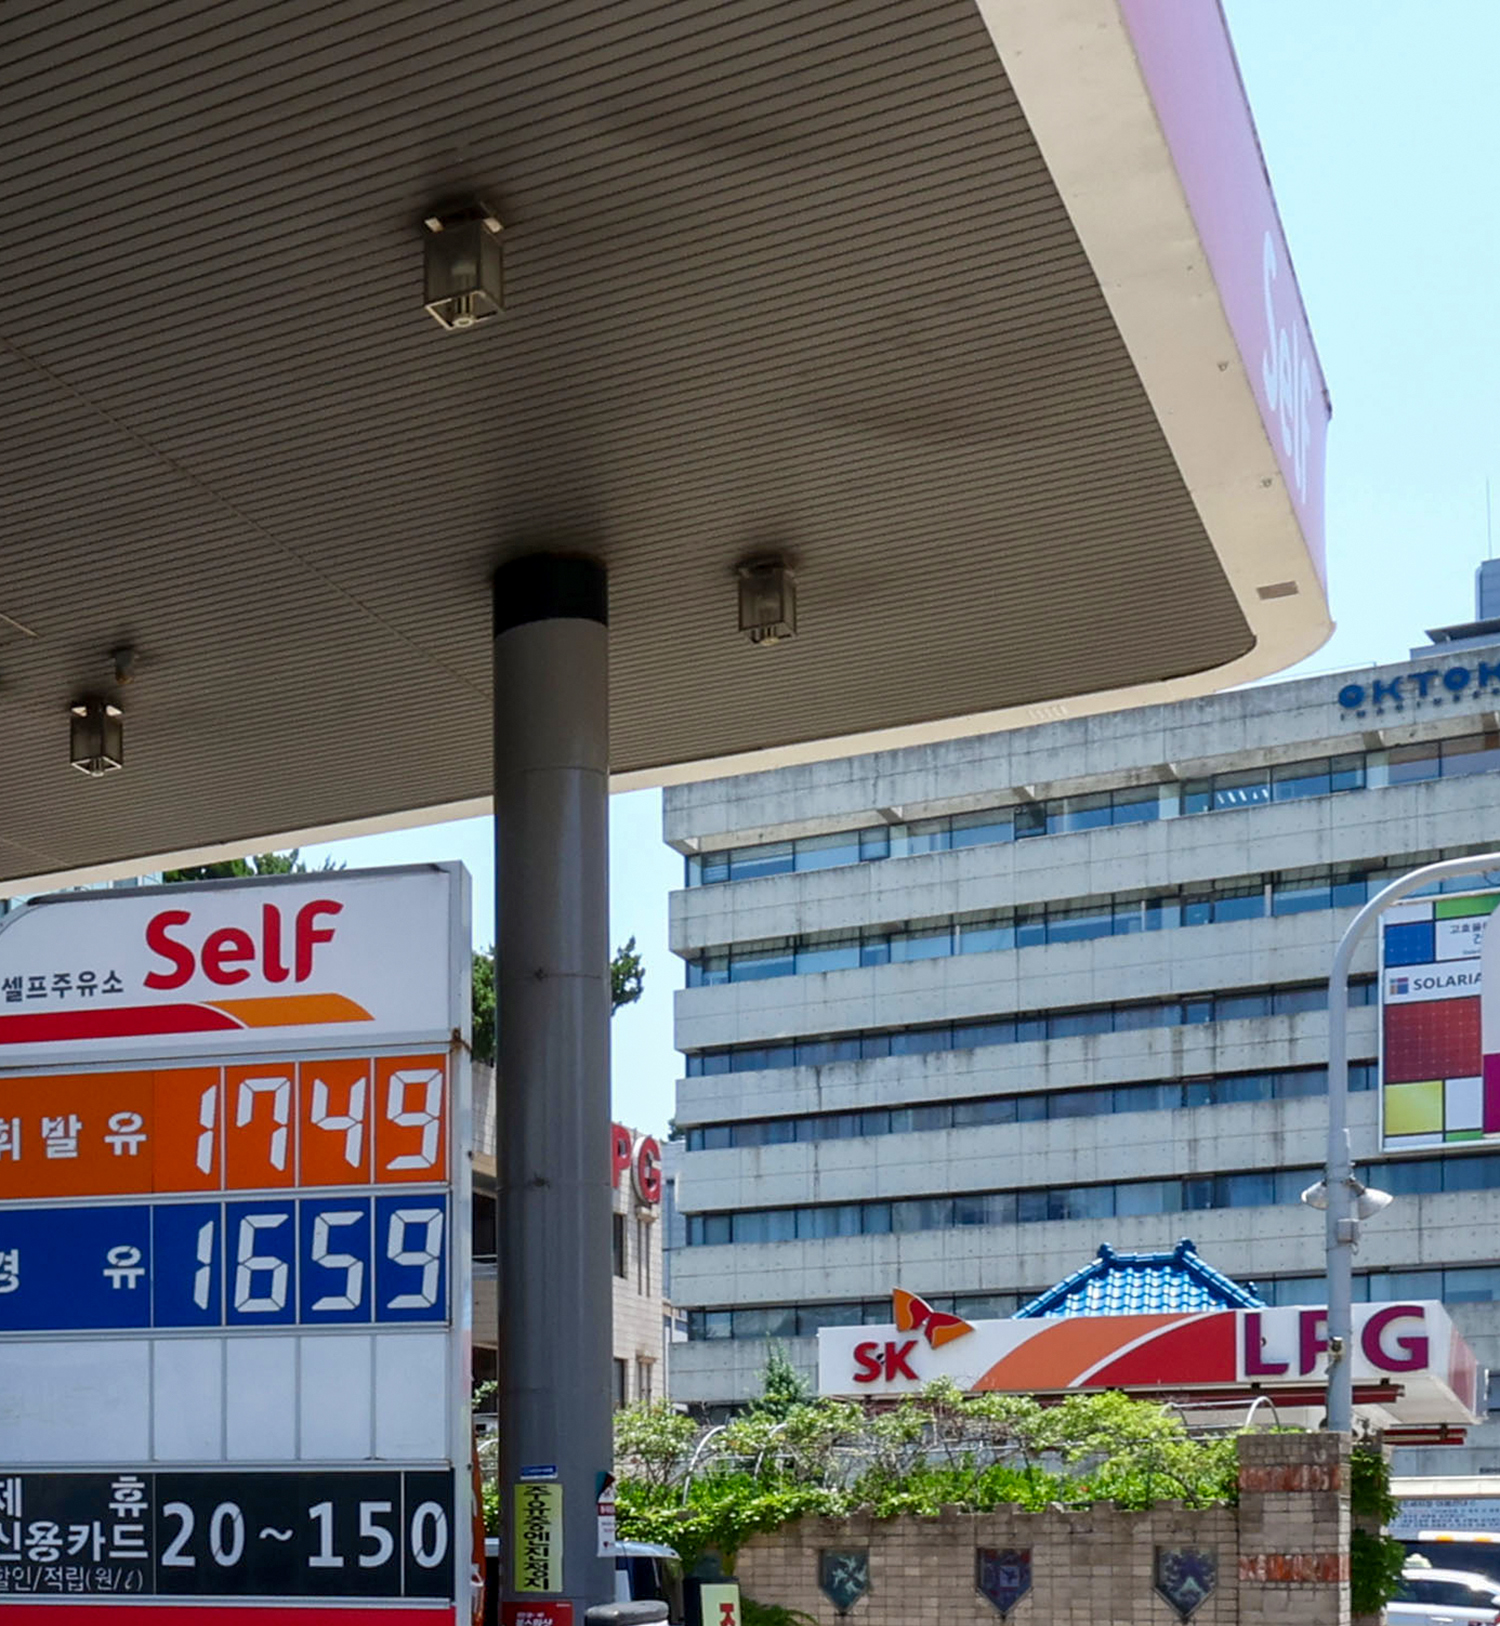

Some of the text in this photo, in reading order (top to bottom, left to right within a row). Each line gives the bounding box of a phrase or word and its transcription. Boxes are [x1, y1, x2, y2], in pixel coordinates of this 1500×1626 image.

[1262, 229, 1312, 506] Self
[1, 970, 124, 1003] 셀프주유소
[143, 899, 345, 990] Self
[195, 1068, 445, 1175] 1749
[193, 1207, 445, 1313] 1659
[852, 1339, 920, 1384] SK
[1244, 1304, 1429, 1377] LPG
